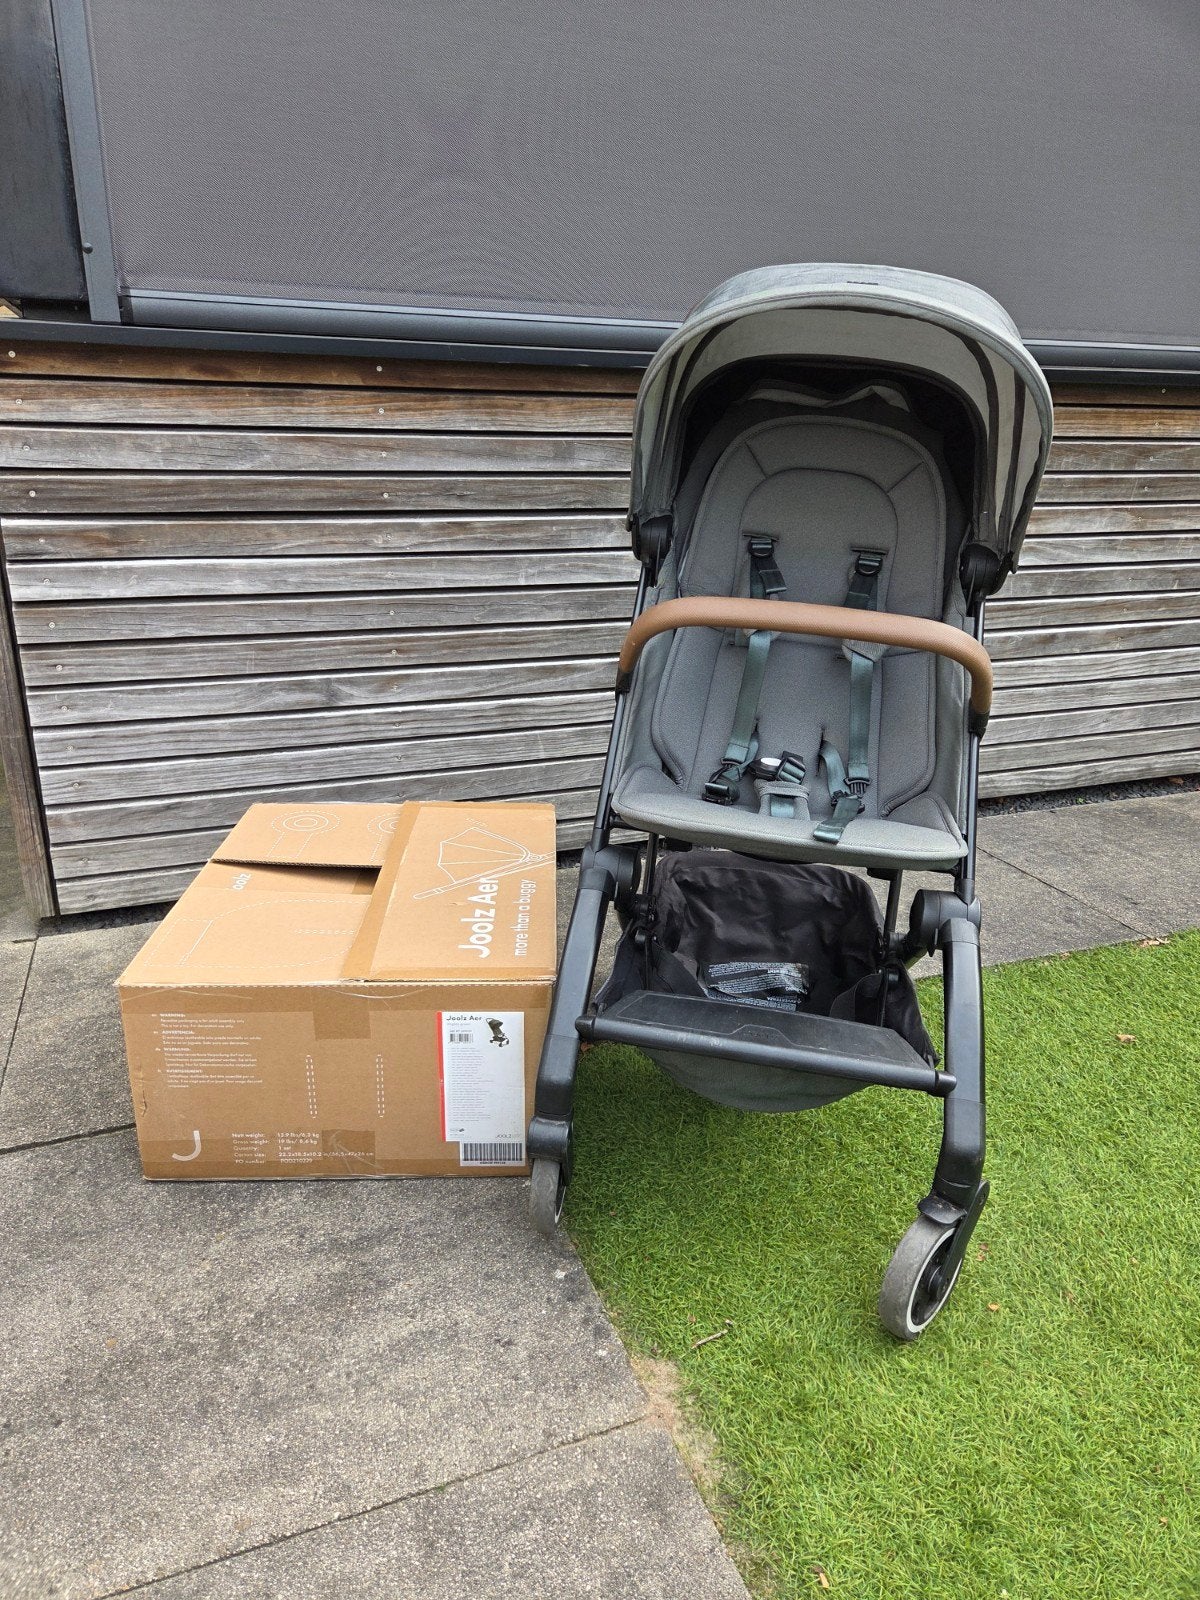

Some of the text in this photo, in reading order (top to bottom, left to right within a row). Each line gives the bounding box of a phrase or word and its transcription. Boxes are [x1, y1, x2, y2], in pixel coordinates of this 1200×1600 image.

[232, 873, 252, 890] oolz
[513, 879, 536, 903] buggy
[457, 877, 499, 958] Joolz Aer
[510, 913, 530, 931] than
[514, 932, 529, 956] more
